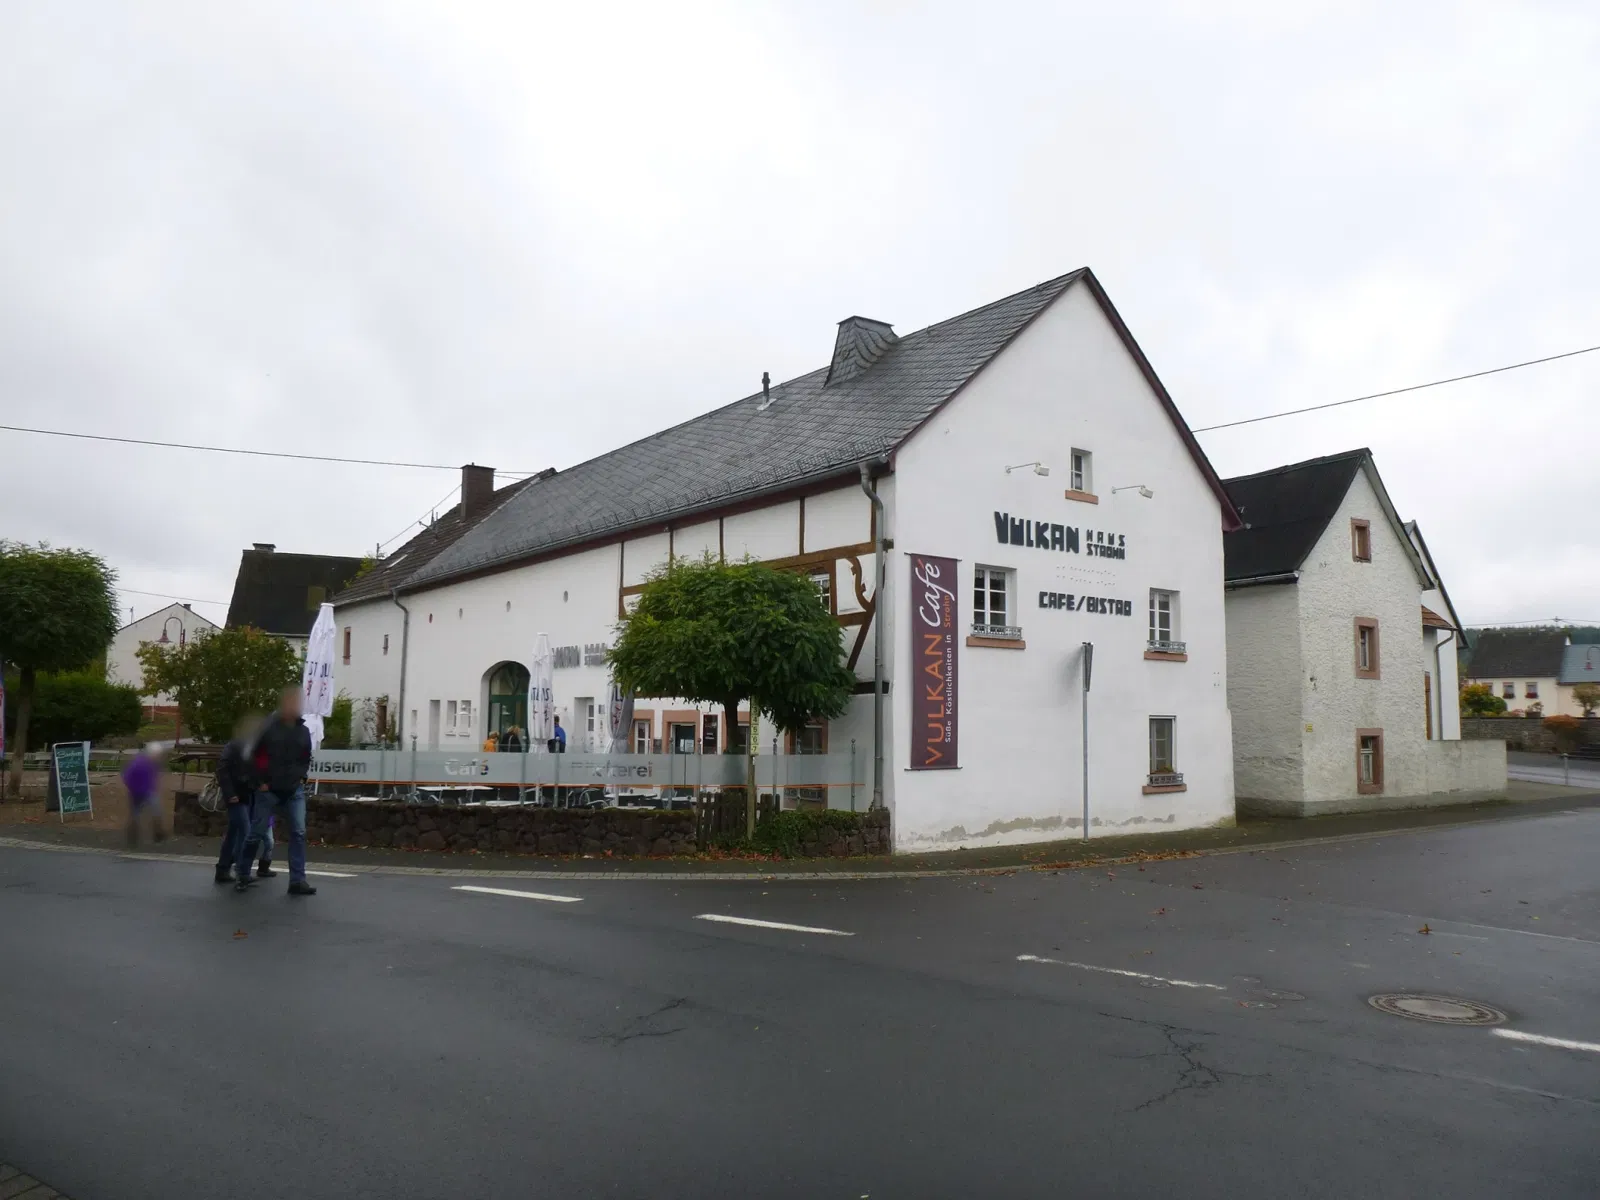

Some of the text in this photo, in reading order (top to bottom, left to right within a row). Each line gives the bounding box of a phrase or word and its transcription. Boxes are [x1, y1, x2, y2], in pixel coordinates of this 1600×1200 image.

[994, 511, 1125, 554] VULKAN HAUS
[1086, 543, 1125, 560] STROHN
[1039, 591, 1132, 616] CAFE/BISTRO
[915, 558, 955, 764] VULKAN Café
[943, 595, 953, 743] Süße Köstlichkeiten in Strohn
[444, 758, 489, 775] Café
